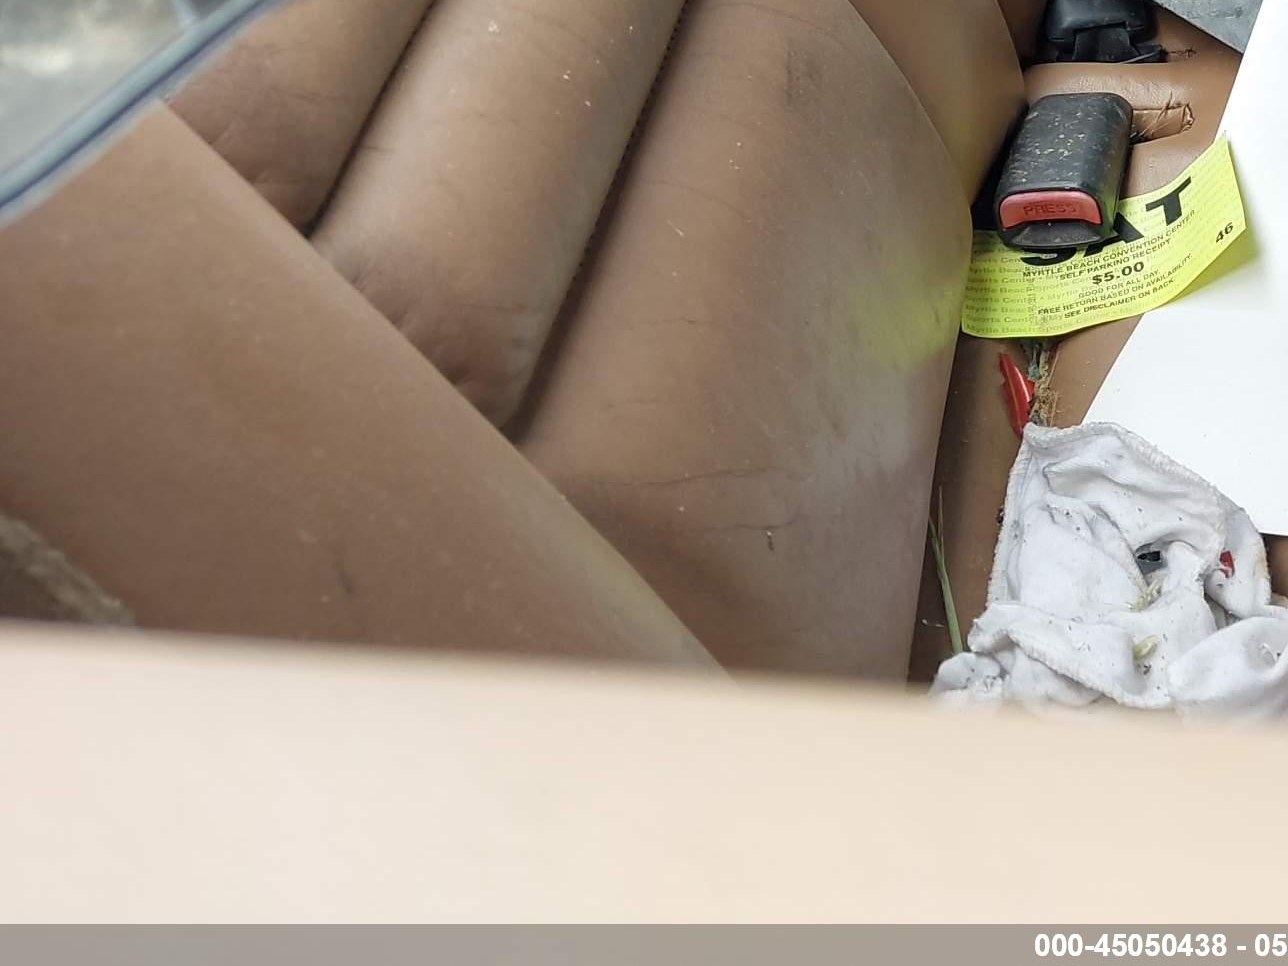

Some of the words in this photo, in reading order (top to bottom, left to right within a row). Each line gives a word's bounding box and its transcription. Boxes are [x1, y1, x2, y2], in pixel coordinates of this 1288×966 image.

[1023, 203, 1077, 215] PRESS
[1022, 266, 1064, 278] MYRTLE
[1066, 258, 1100, 271] BEACH
[1103, 235, 1164, 262] CONVENTION
[1165, 209, 1196, 237] CENTER
[1215, 222, 1234, 243] 46
[1060, 269, 1086, 280] SELF
[1087, 256, 1130, 274] PARKING
[1133, 238, 1172, 260] RECEIPT
[1092, 261, 1144, 285] $5.00
[1038, 305, 1061, 316] FREE
[1063, 297, 1098, 311] RETURN
[1100, 288, 1129, 302] BASED
[1132, 284, 1144, 293] ON
[1078, 287, 1104, 299] GOOD
[1106, 281, 1125, 293] FOR
[1126, 277, 1141, 286] ALL
[1064, 309, 1081, 319] SEE
[1084, 295, 1137, 314] DISCLAIMER
[1138, 290, 1151, 300] ON
